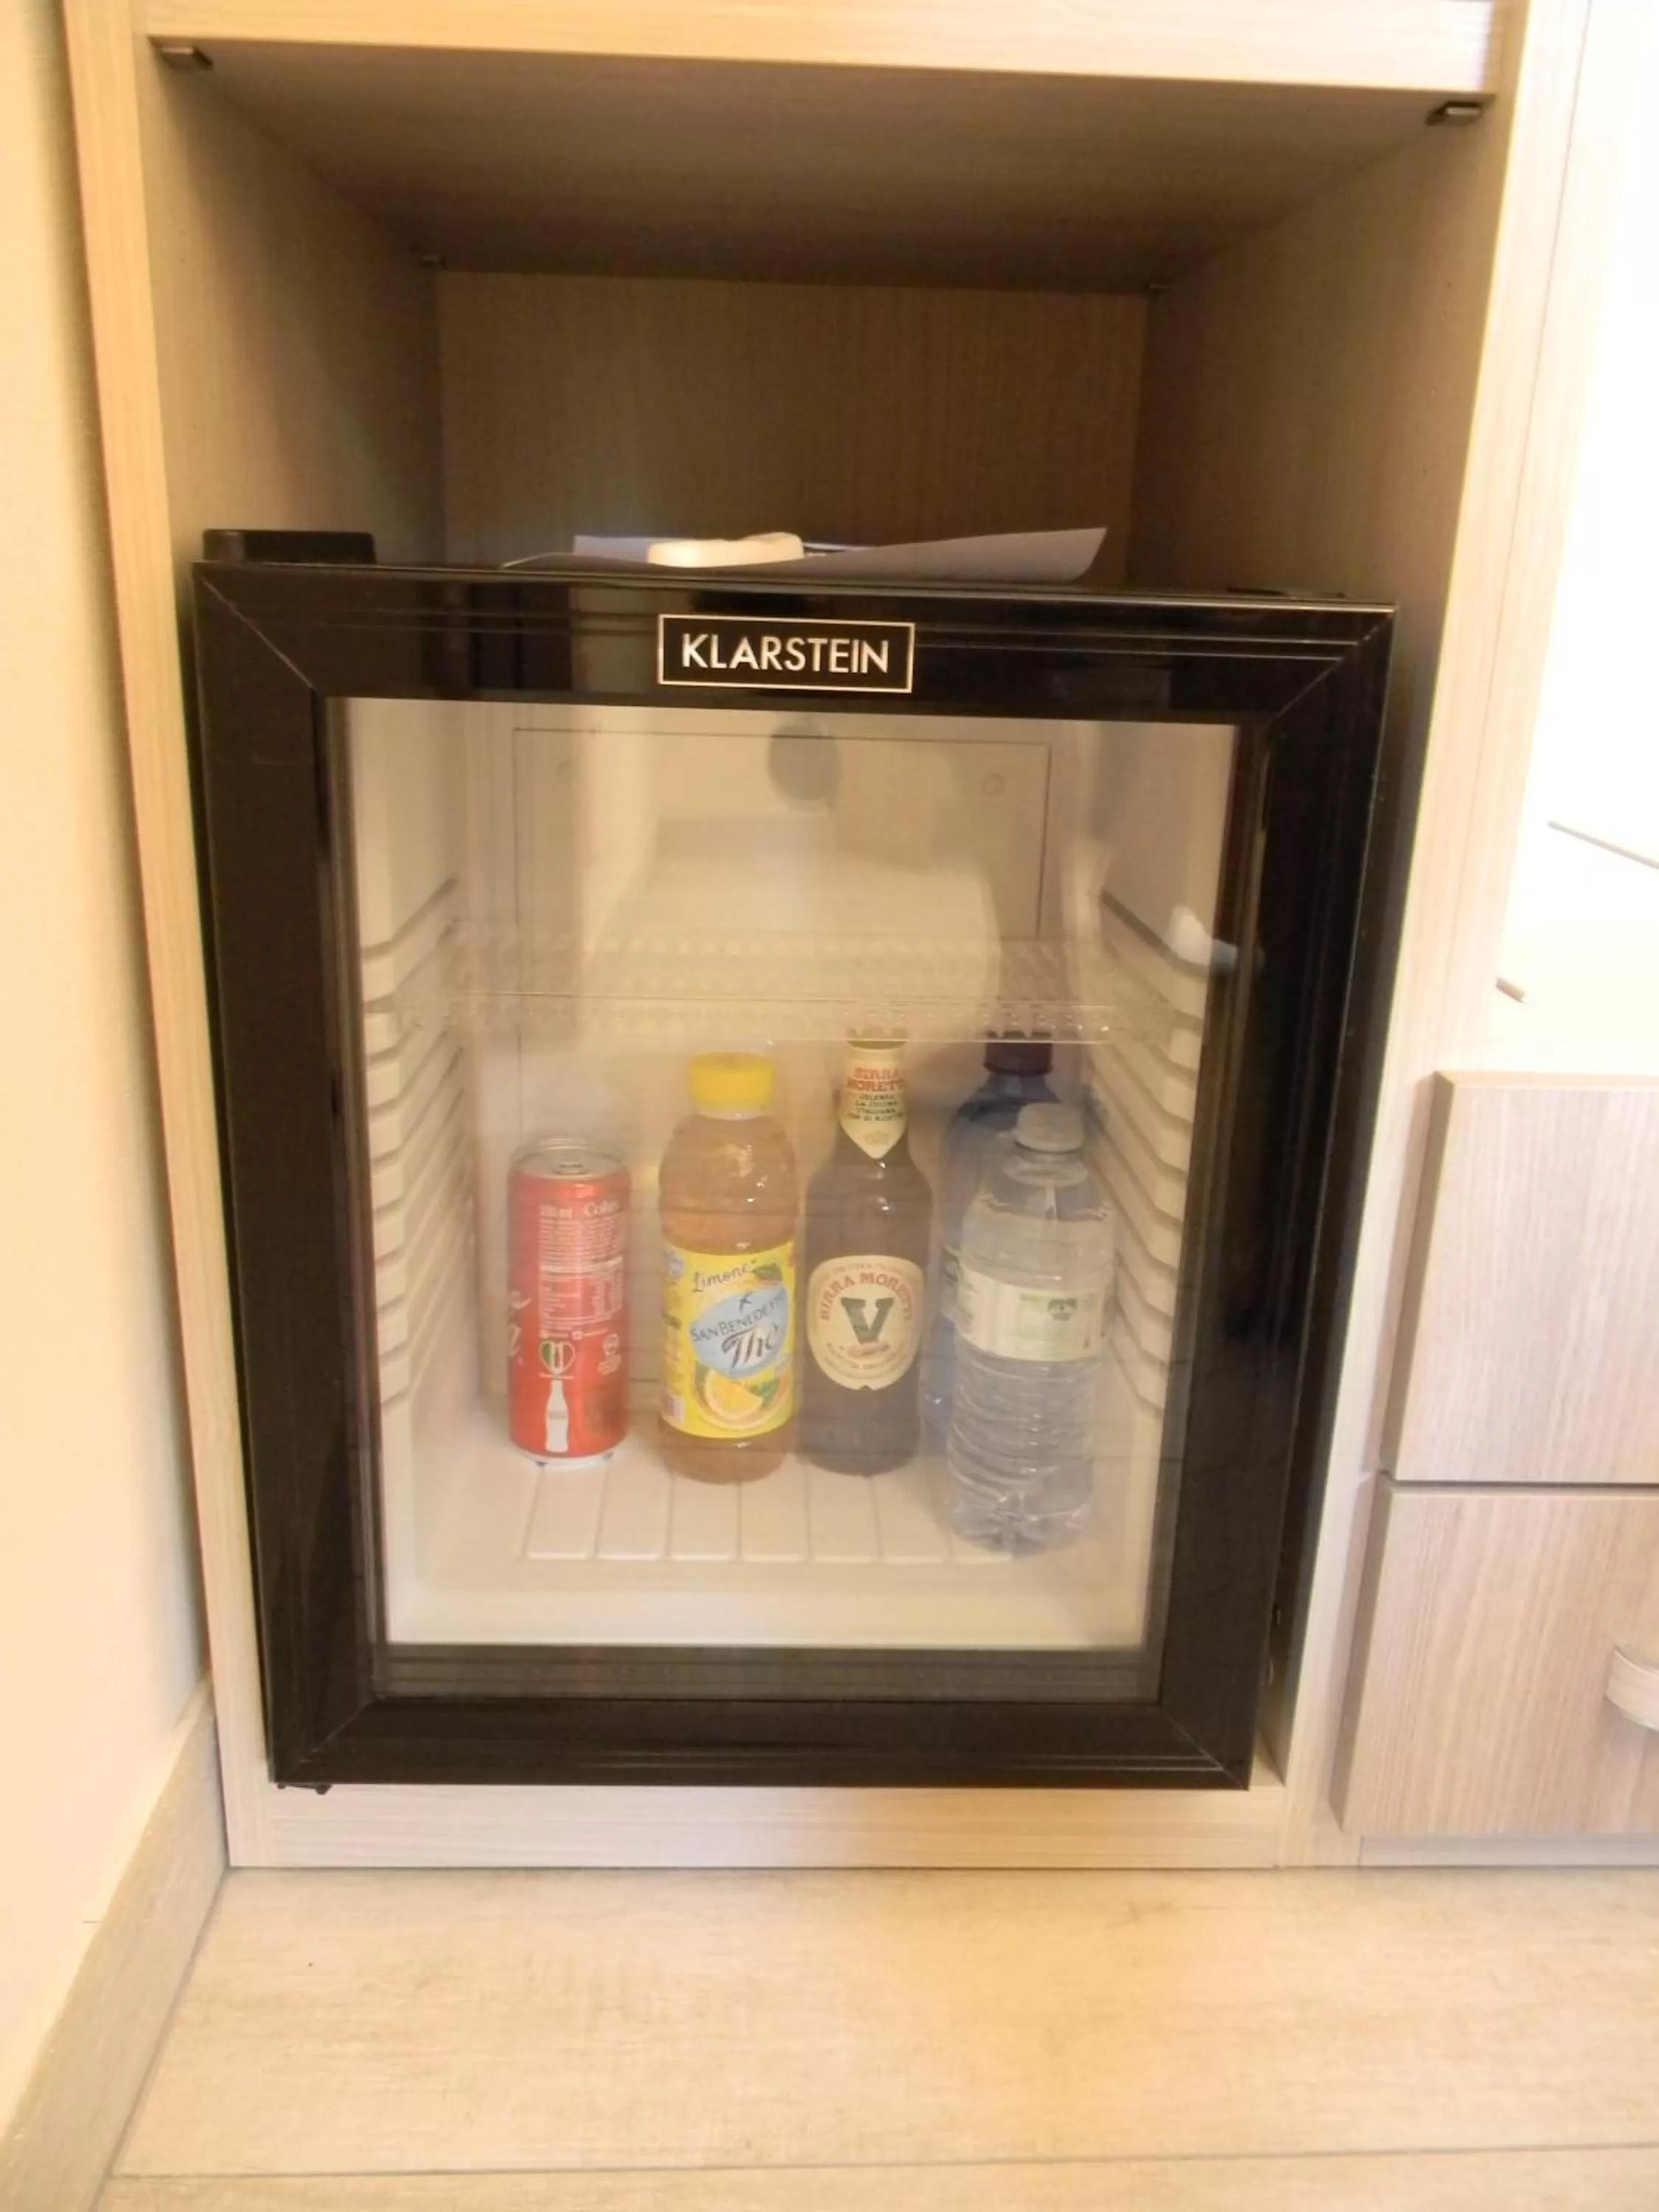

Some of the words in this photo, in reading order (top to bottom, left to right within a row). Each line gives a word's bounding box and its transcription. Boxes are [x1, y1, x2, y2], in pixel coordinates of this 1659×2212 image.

[681, 633, 889, 673] KLARSTEIN
[692, 1262, 751, 1293] Limone
[820, 1276, 856, 1322] BIRRA
